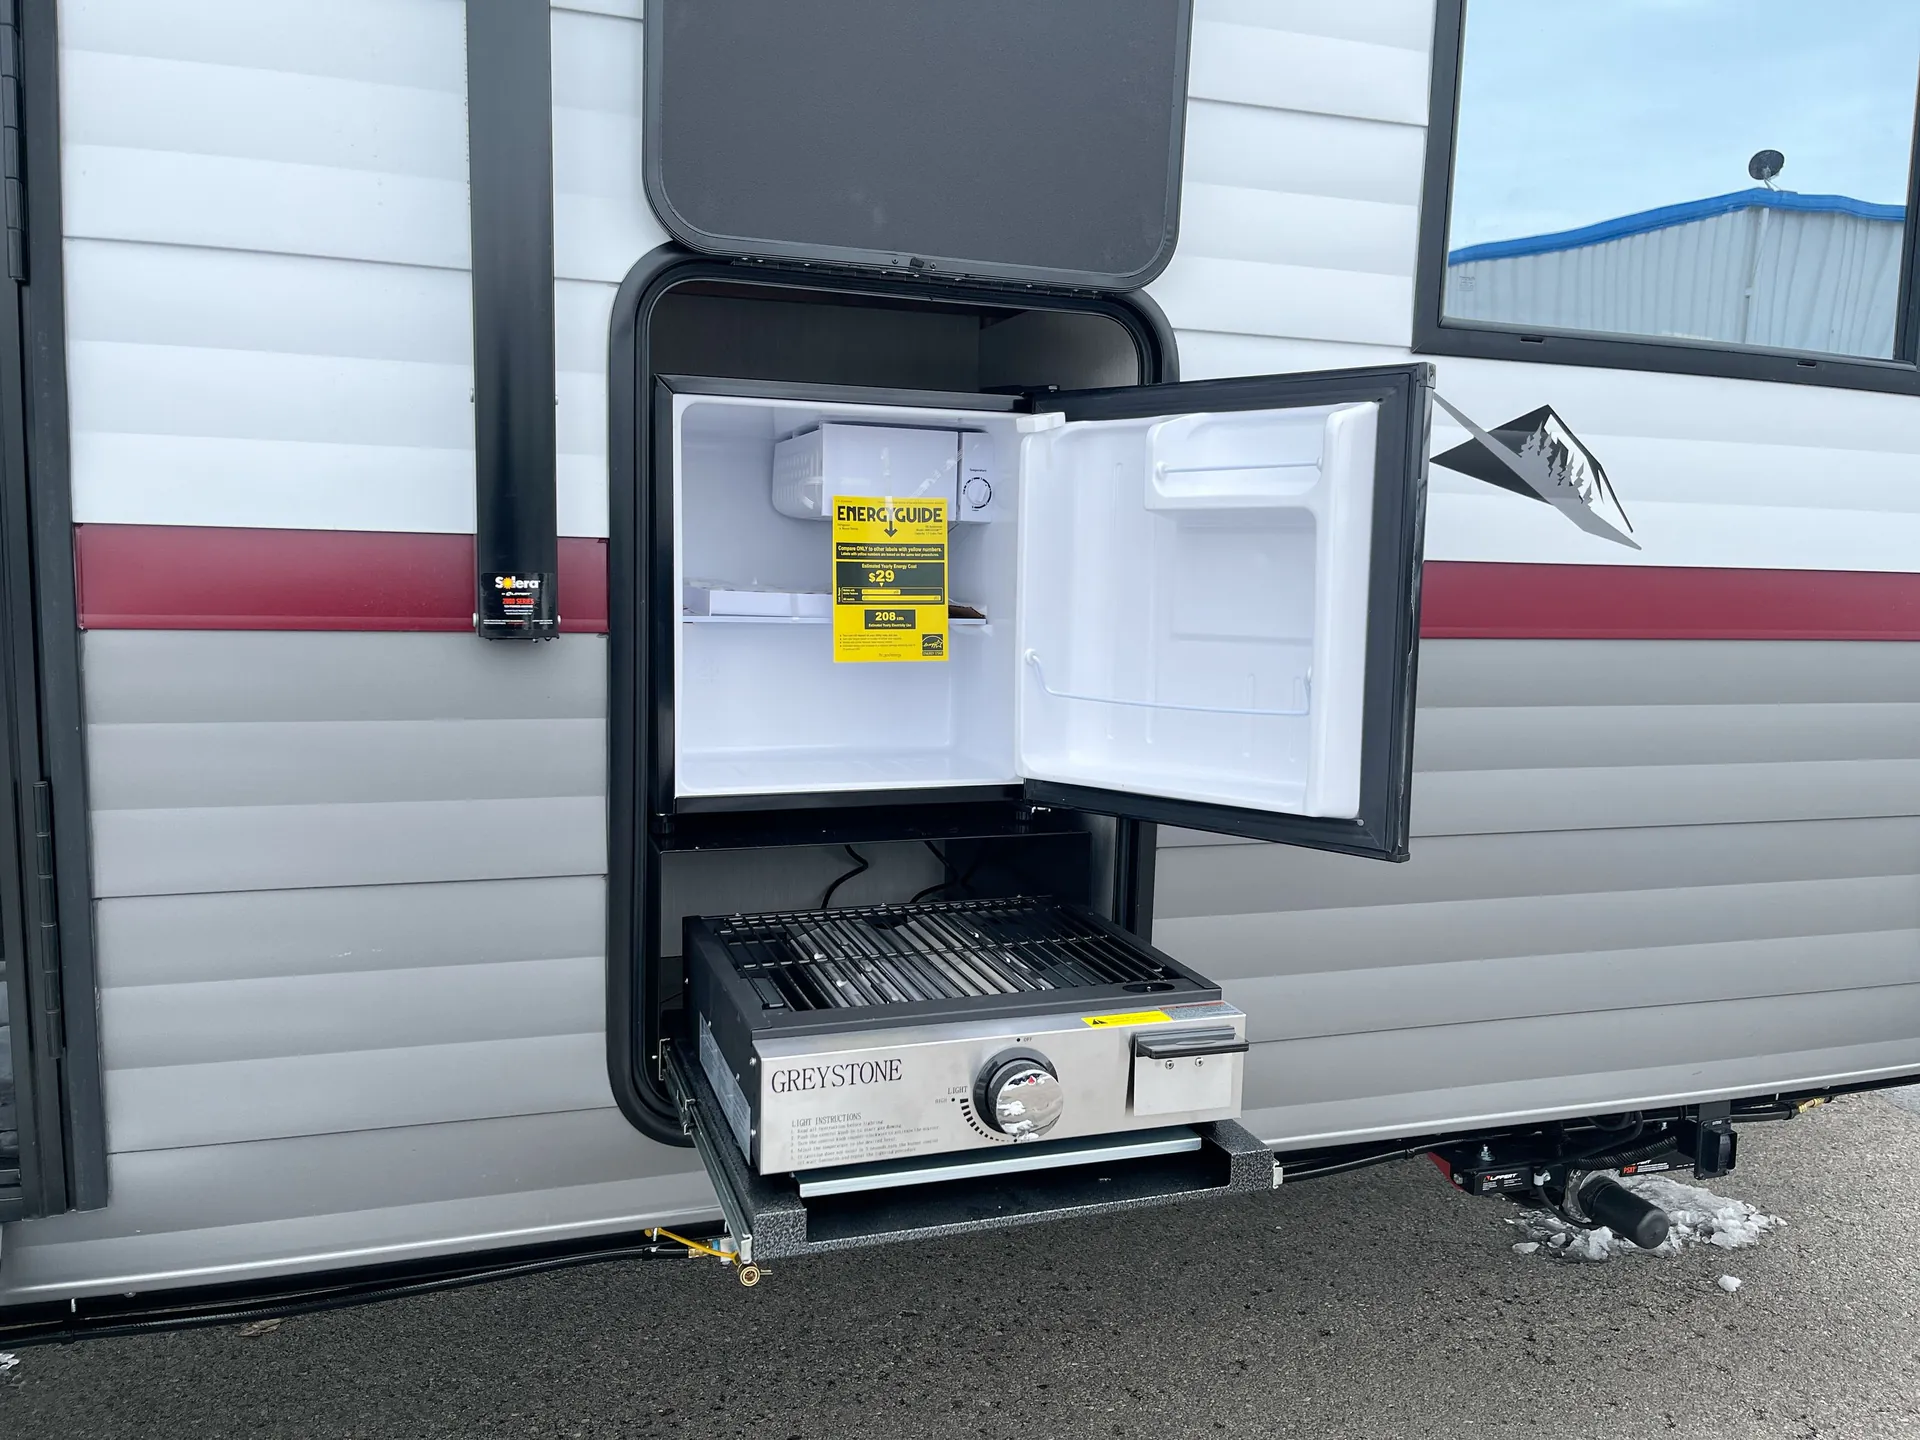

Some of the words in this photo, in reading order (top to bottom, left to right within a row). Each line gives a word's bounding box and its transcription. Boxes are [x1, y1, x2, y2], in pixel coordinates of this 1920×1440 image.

[495, 575, 540, 589] Solera
[868, 570, 895, 583] $29
[875, 611, 896, 621] 208
[771, 1058, 903, 1094] GREYSTONE
[947, 1085, 968, 1095] LIGHT
[791, 1118, 812, 1128] LIGHT
[815, 1112, 862, 1125] INSTRUCTIONS
